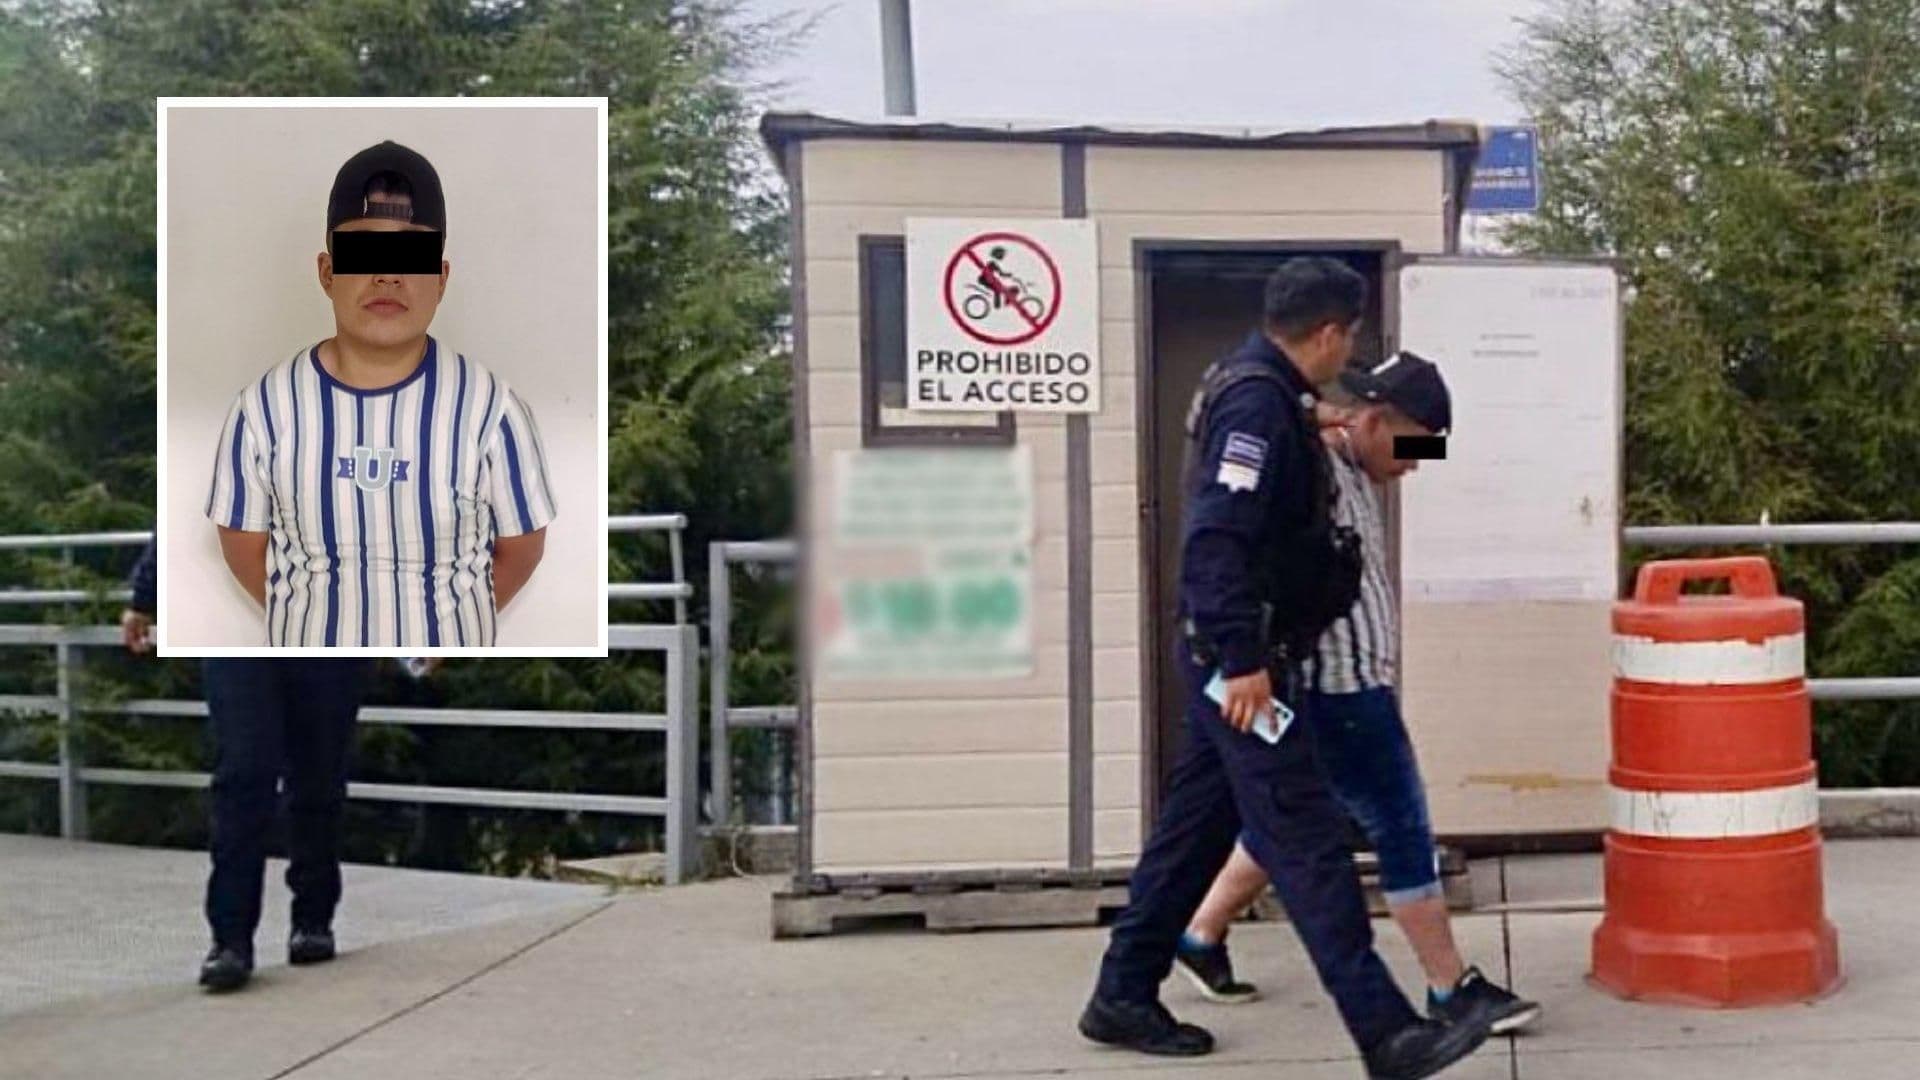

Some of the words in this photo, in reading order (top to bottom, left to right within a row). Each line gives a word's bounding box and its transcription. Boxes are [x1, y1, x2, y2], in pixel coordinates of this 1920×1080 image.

[917, 350, 1090, 375] PROHIBIDO
[918, 379, 953, 402] EL
[963, 380, 1088, 404] ACCESO
[354, 447, 394, 492] U
